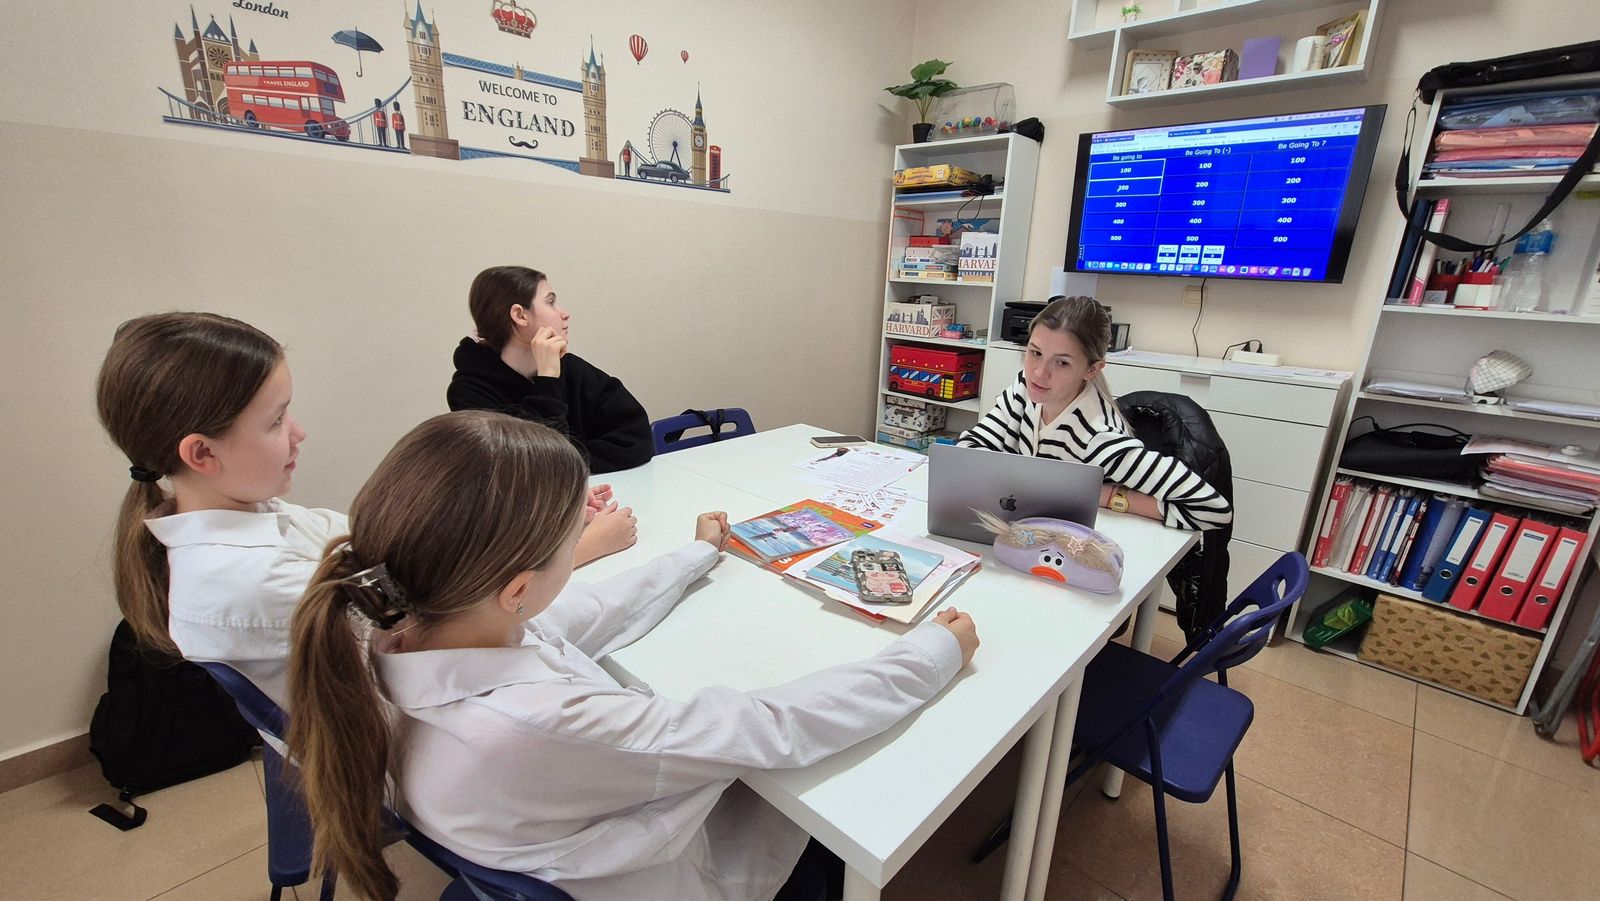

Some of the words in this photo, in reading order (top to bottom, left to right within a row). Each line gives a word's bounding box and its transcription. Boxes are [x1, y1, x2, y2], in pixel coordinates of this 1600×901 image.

[233, 0, 288, 19] London
[478, 80, 540, 103] WELCOME
[542, 93, 558, 106] TO
[461, 100, 575, 137] ENGLAND
[1195, 148, 1212, 156] Going
[1289, 141, 1309, 149] Going
[1120, 154, 1135, 162] going
[886, 322, 931, 337] HARVARD
